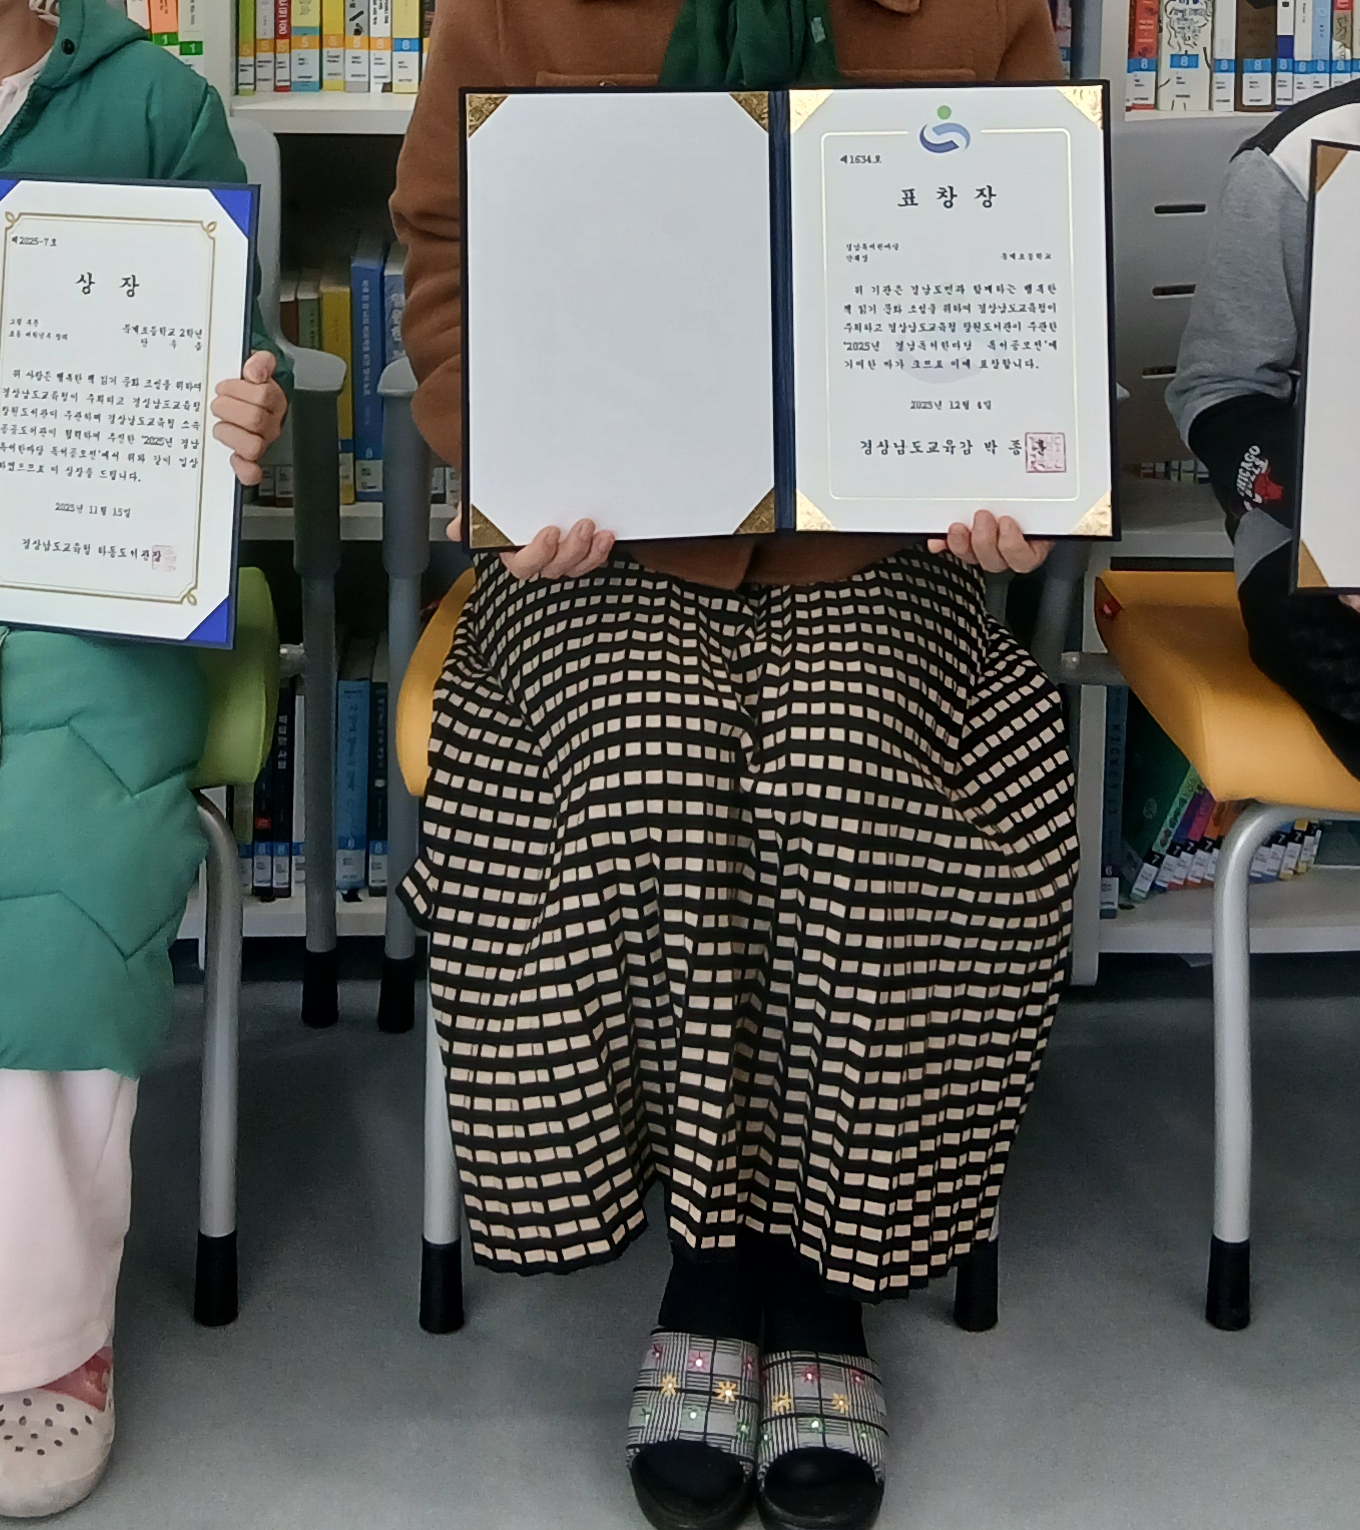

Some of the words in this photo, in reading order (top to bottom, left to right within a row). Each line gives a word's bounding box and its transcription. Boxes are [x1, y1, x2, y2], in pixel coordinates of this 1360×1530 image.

[898, 188, 918, 207] 표
[936, 185, 957, 208] 창
[974, 185, 997, 208] 장
[75, 272, 96, 295] 상
[120, 274, 140, 298] 장
[910, 400, 942, 411] 2025년
[860, 439, 974, 456] 경상남도교육감
[984, 440, 998, 455] 박
[22, 539, 91, 556] 경상남도교육청
